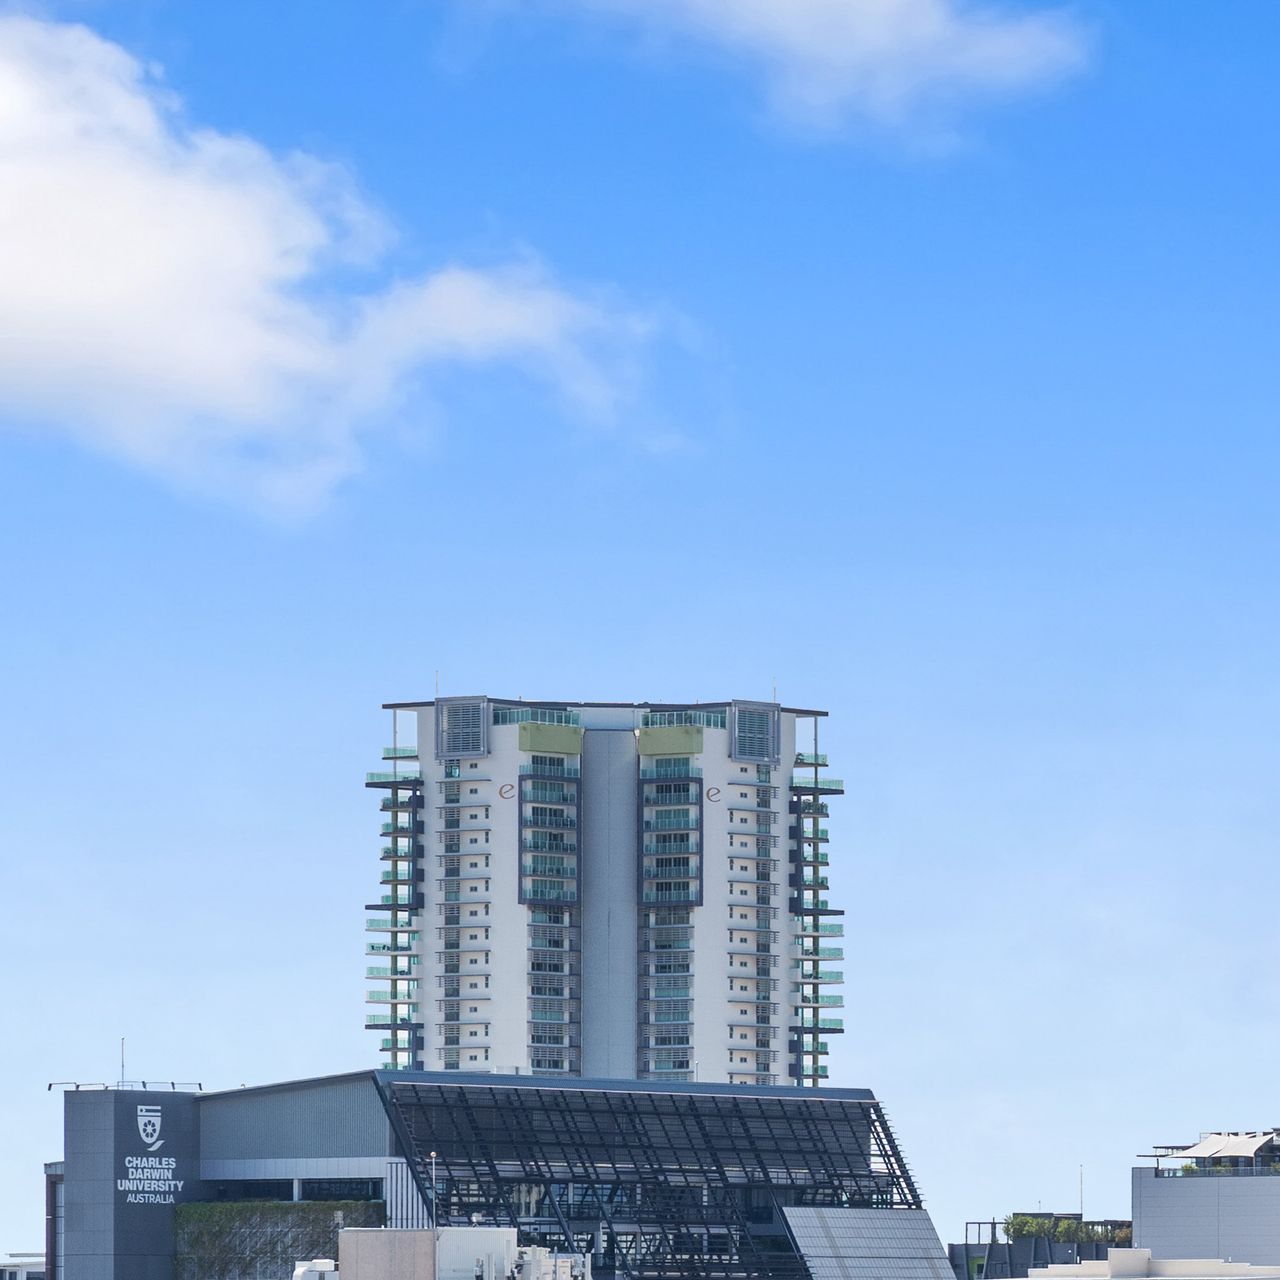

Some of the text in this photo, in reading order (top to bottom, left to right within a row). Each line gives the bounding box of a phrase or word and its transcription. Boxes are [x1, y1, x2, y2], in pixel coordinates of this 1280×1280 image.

[125, 1156, 176, 1169] CHARLES
[128, 1168, 173, 1180] DARWIN
[117, 1179, 184, 1192] UNIVERSITY
[126, 1193, 175, 1204] AUSTRALIA
